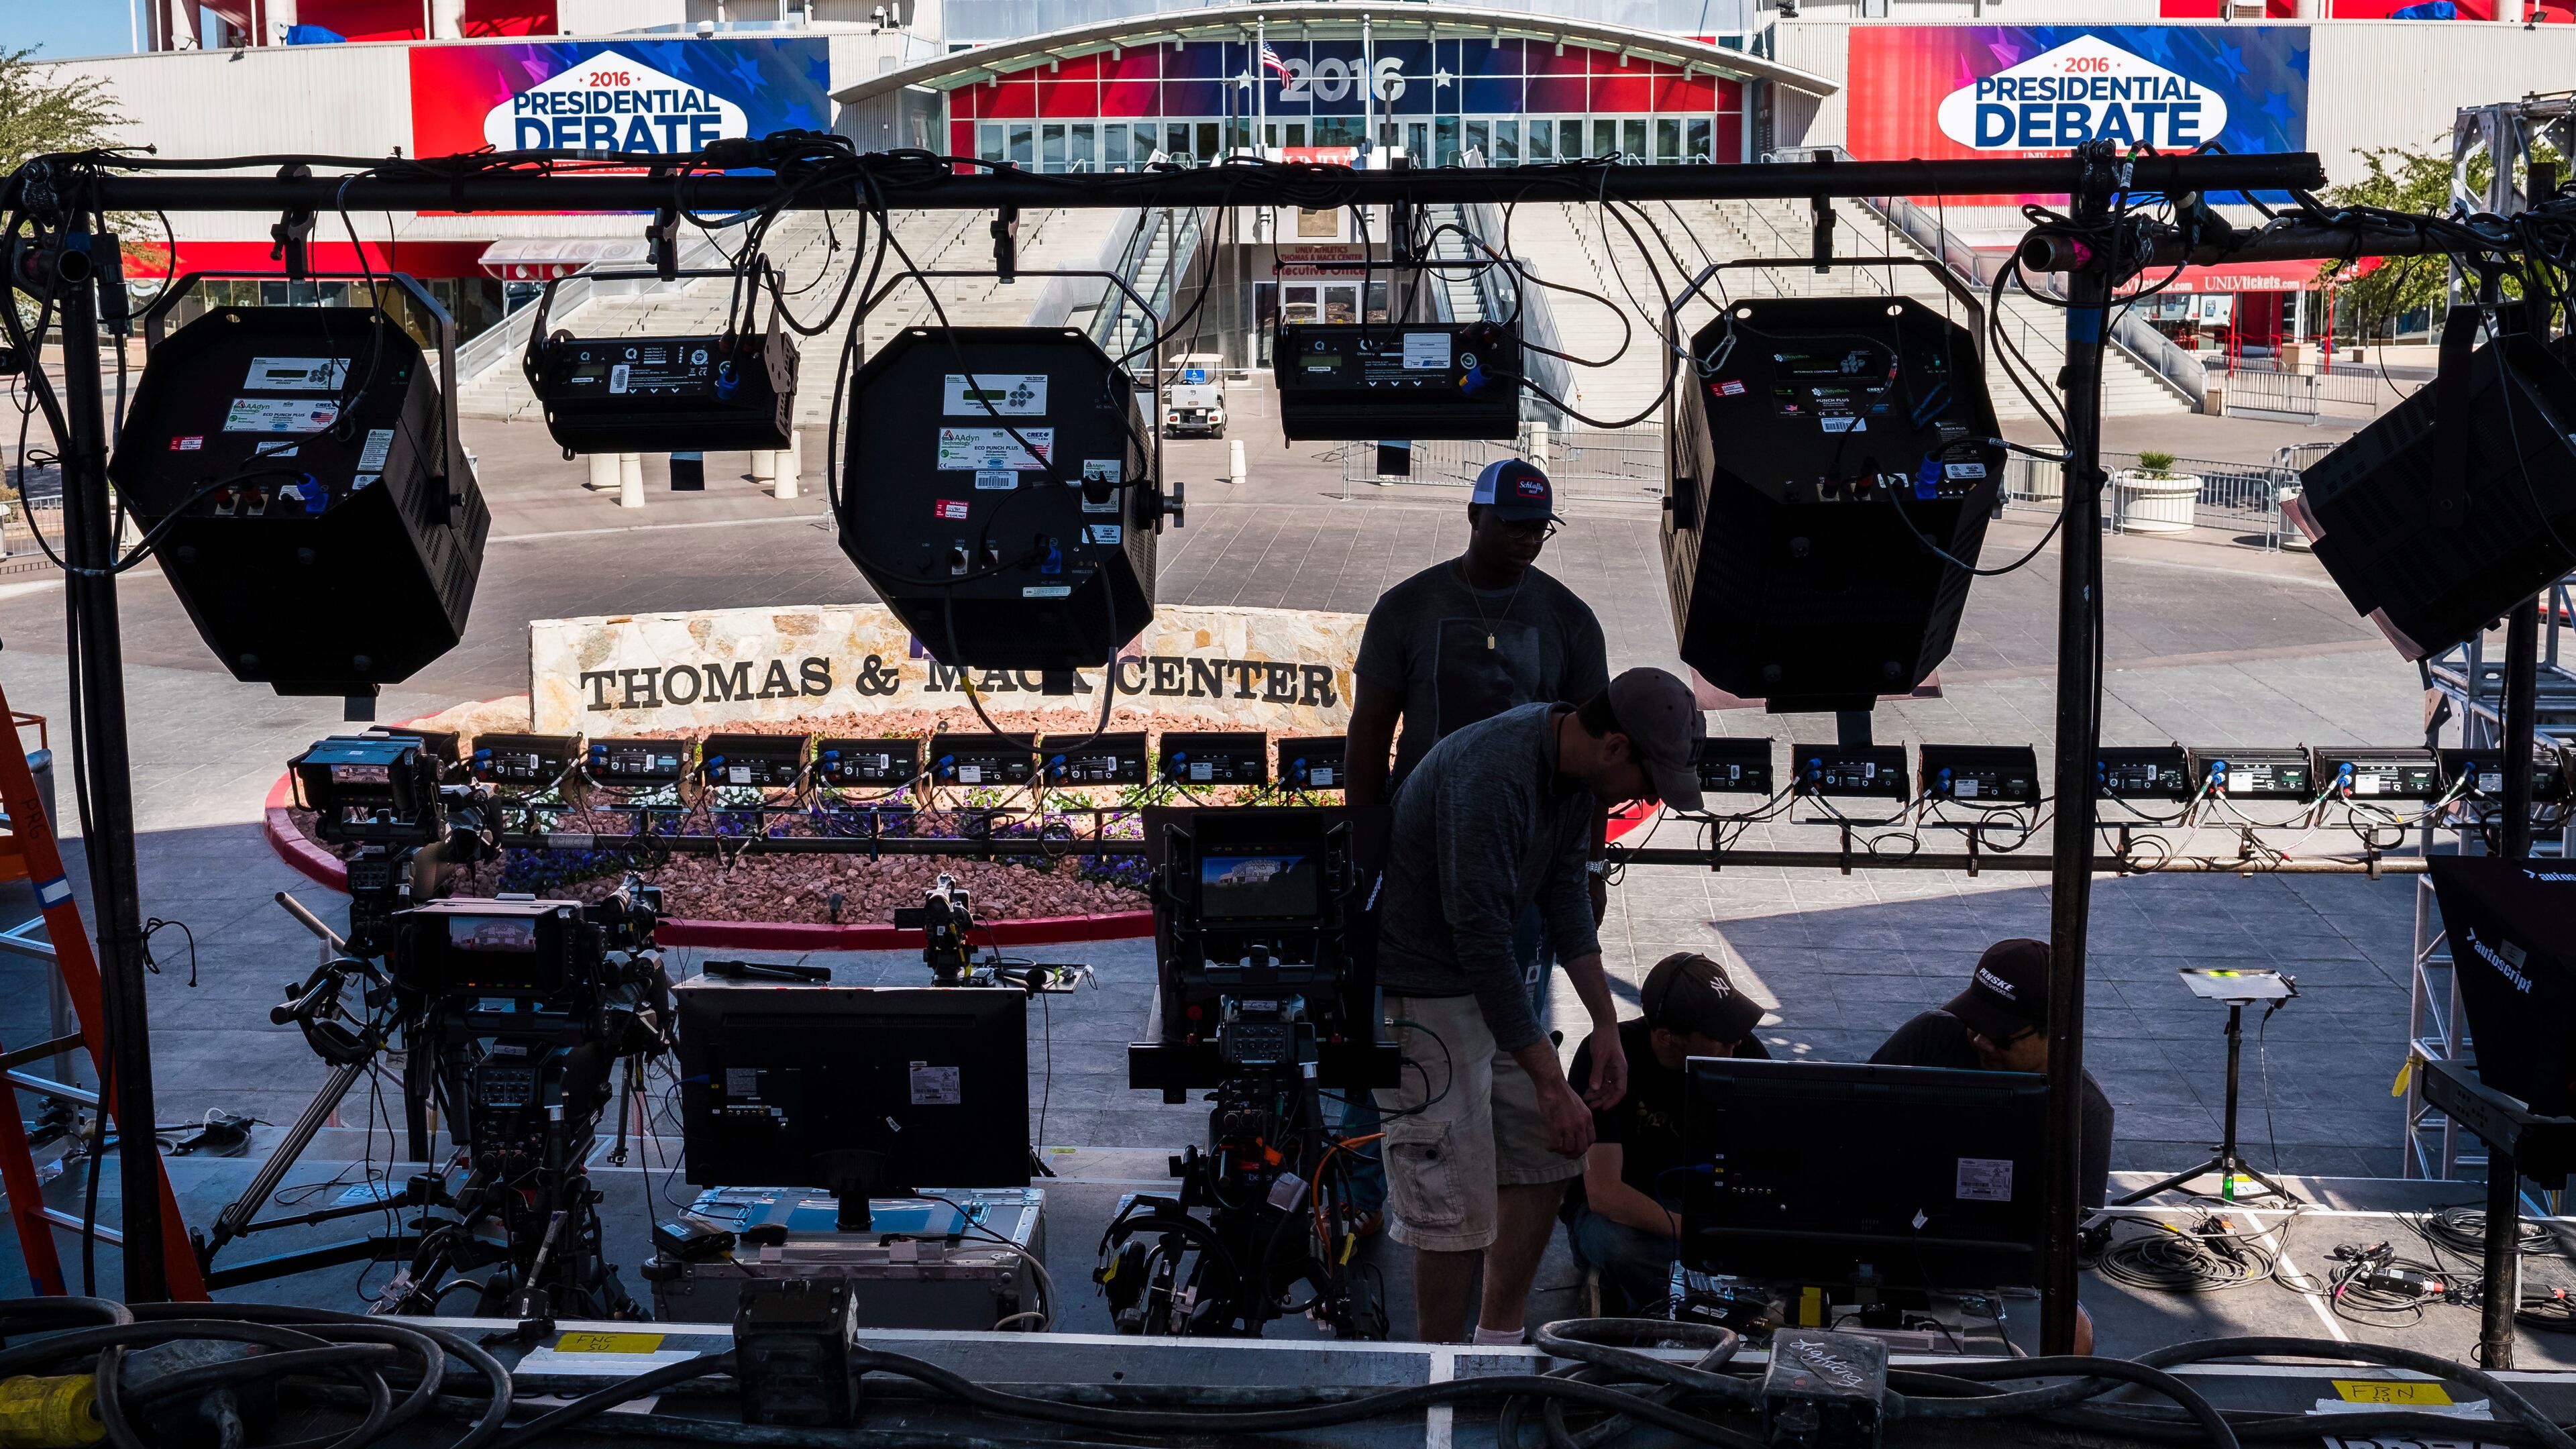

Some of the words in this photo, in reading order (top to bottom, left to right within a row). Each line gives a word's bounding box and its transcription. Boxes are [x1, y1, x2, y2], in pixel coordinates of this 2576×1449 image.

[2065, 57, 2109, 72] 2016
[590, 71, 631, 87] 2016
[1280, 57, 1405, 101] 2016
[1976, 77, 2201, 101] PRESIDENTIAL
[514, 90, 720, 115] PRESIDENTIAL
[515, 114, 722, 153] DEBATE
[1975, 103, 2200, 147] DEBATE
[2205, 276, 2299, 291] UNLVtickets.com
[1519, 480, 1544, 492] Schlafly
[581, 656, 832, 712] THOMAS
[856, 655, 899, 696] &
[1115, 655, 1337, 708] CENTER
[19, 798, 46, 839] PRG
[1980, 967, 2015, 991] PENSKE
[2474, 940, 2532, 994] autoscript
[1988, 983, 2006, 996] SHOCKS
[577, 1335, 618, 1344] FNC
[586, 1344, 609, 1352] SU
[1790, 1339, 1865, 1389] Lighting
